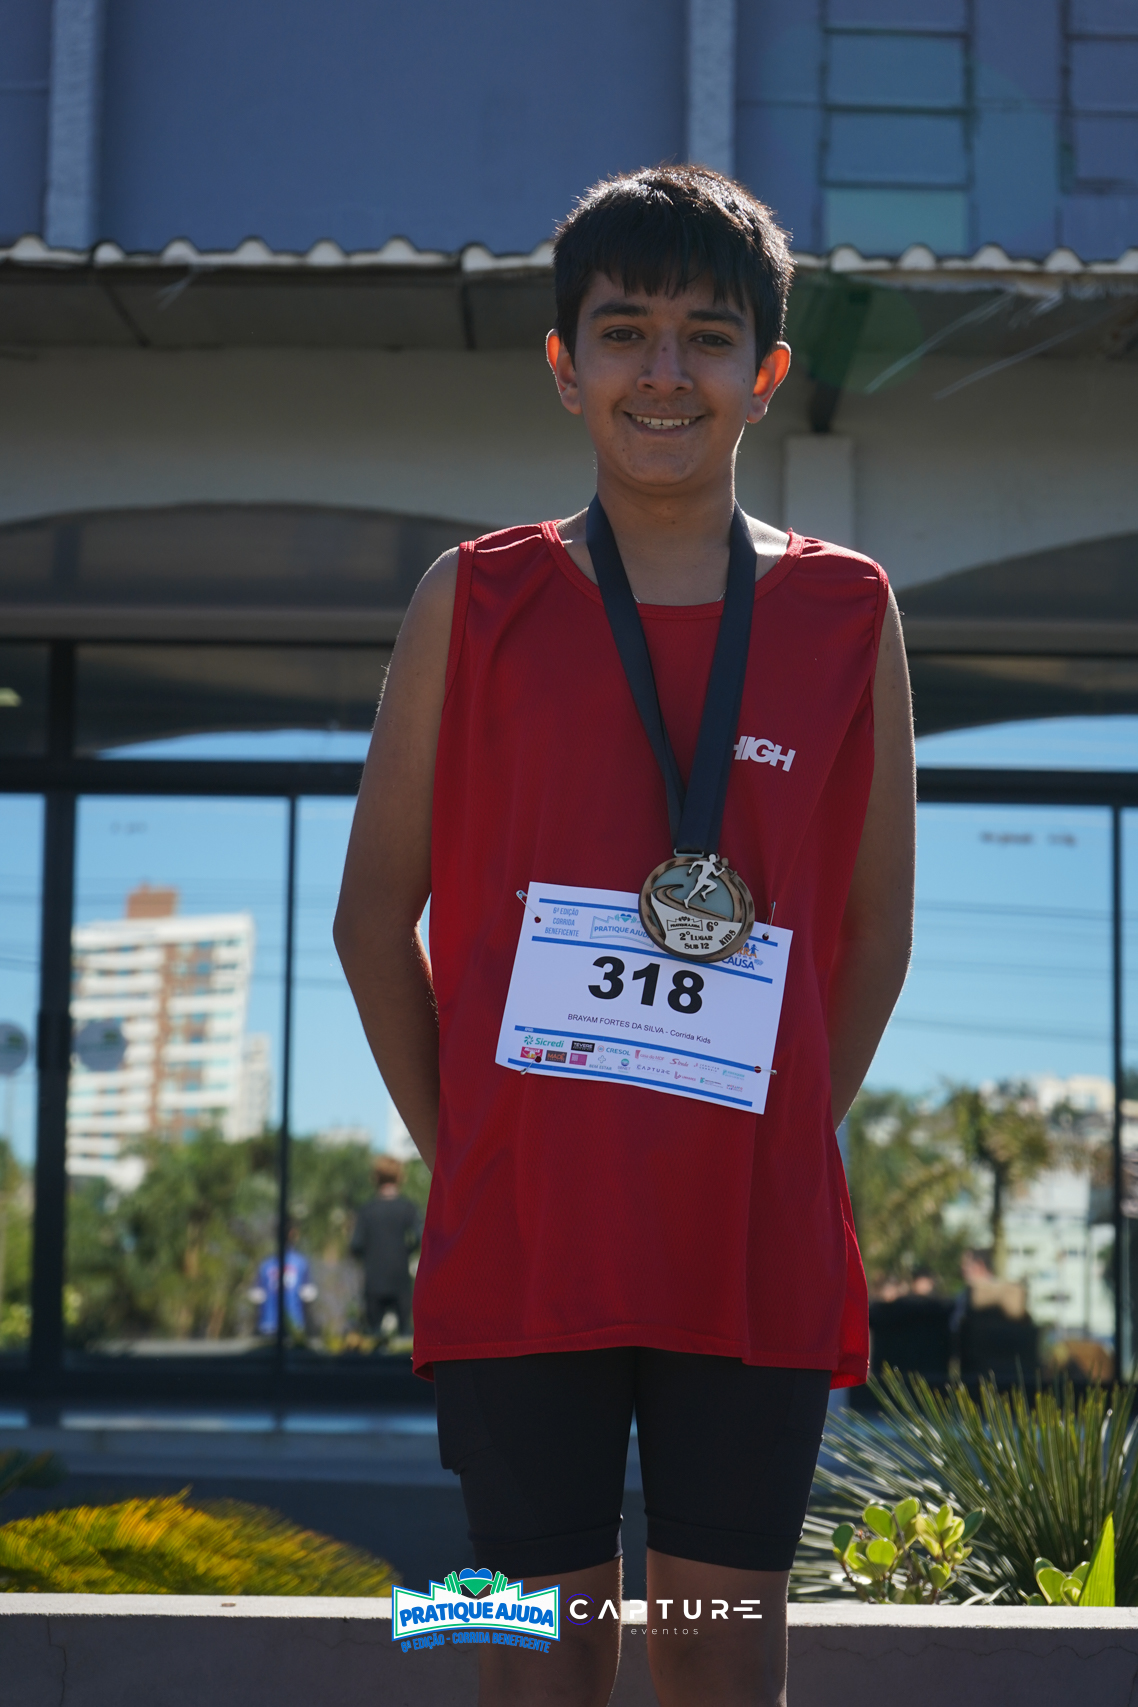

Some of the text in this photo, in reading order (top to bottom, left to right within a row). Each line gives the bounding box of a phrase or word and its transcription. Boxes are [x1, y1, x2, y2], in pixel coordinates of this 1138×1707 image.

[560, 907, 579, 917] EDIÇÃO
[552, 917, 575, 926] CORRIDA
[544, 927, 580, 937] BENEFICENTE
[594, 925, 650, 939] PRATIQUE AJUD
[719, 929, 736, 946] KIDS
[588, 955, 705, 1014] 318
[567, 1013, 598, 1024] BRAYAM
[600, 1017, 630, 1028] FORTES
[631, 1022, 643, 1030] DA
[644, 1024, 664, 1034] SILVA
[670, 1029, 695, 1041] Corrida
[696, 1035, 711, 1044] Kids
[534, 1037, 565, 1048] Sicredi
[606, 1047, 630, 1056] CRESOL
